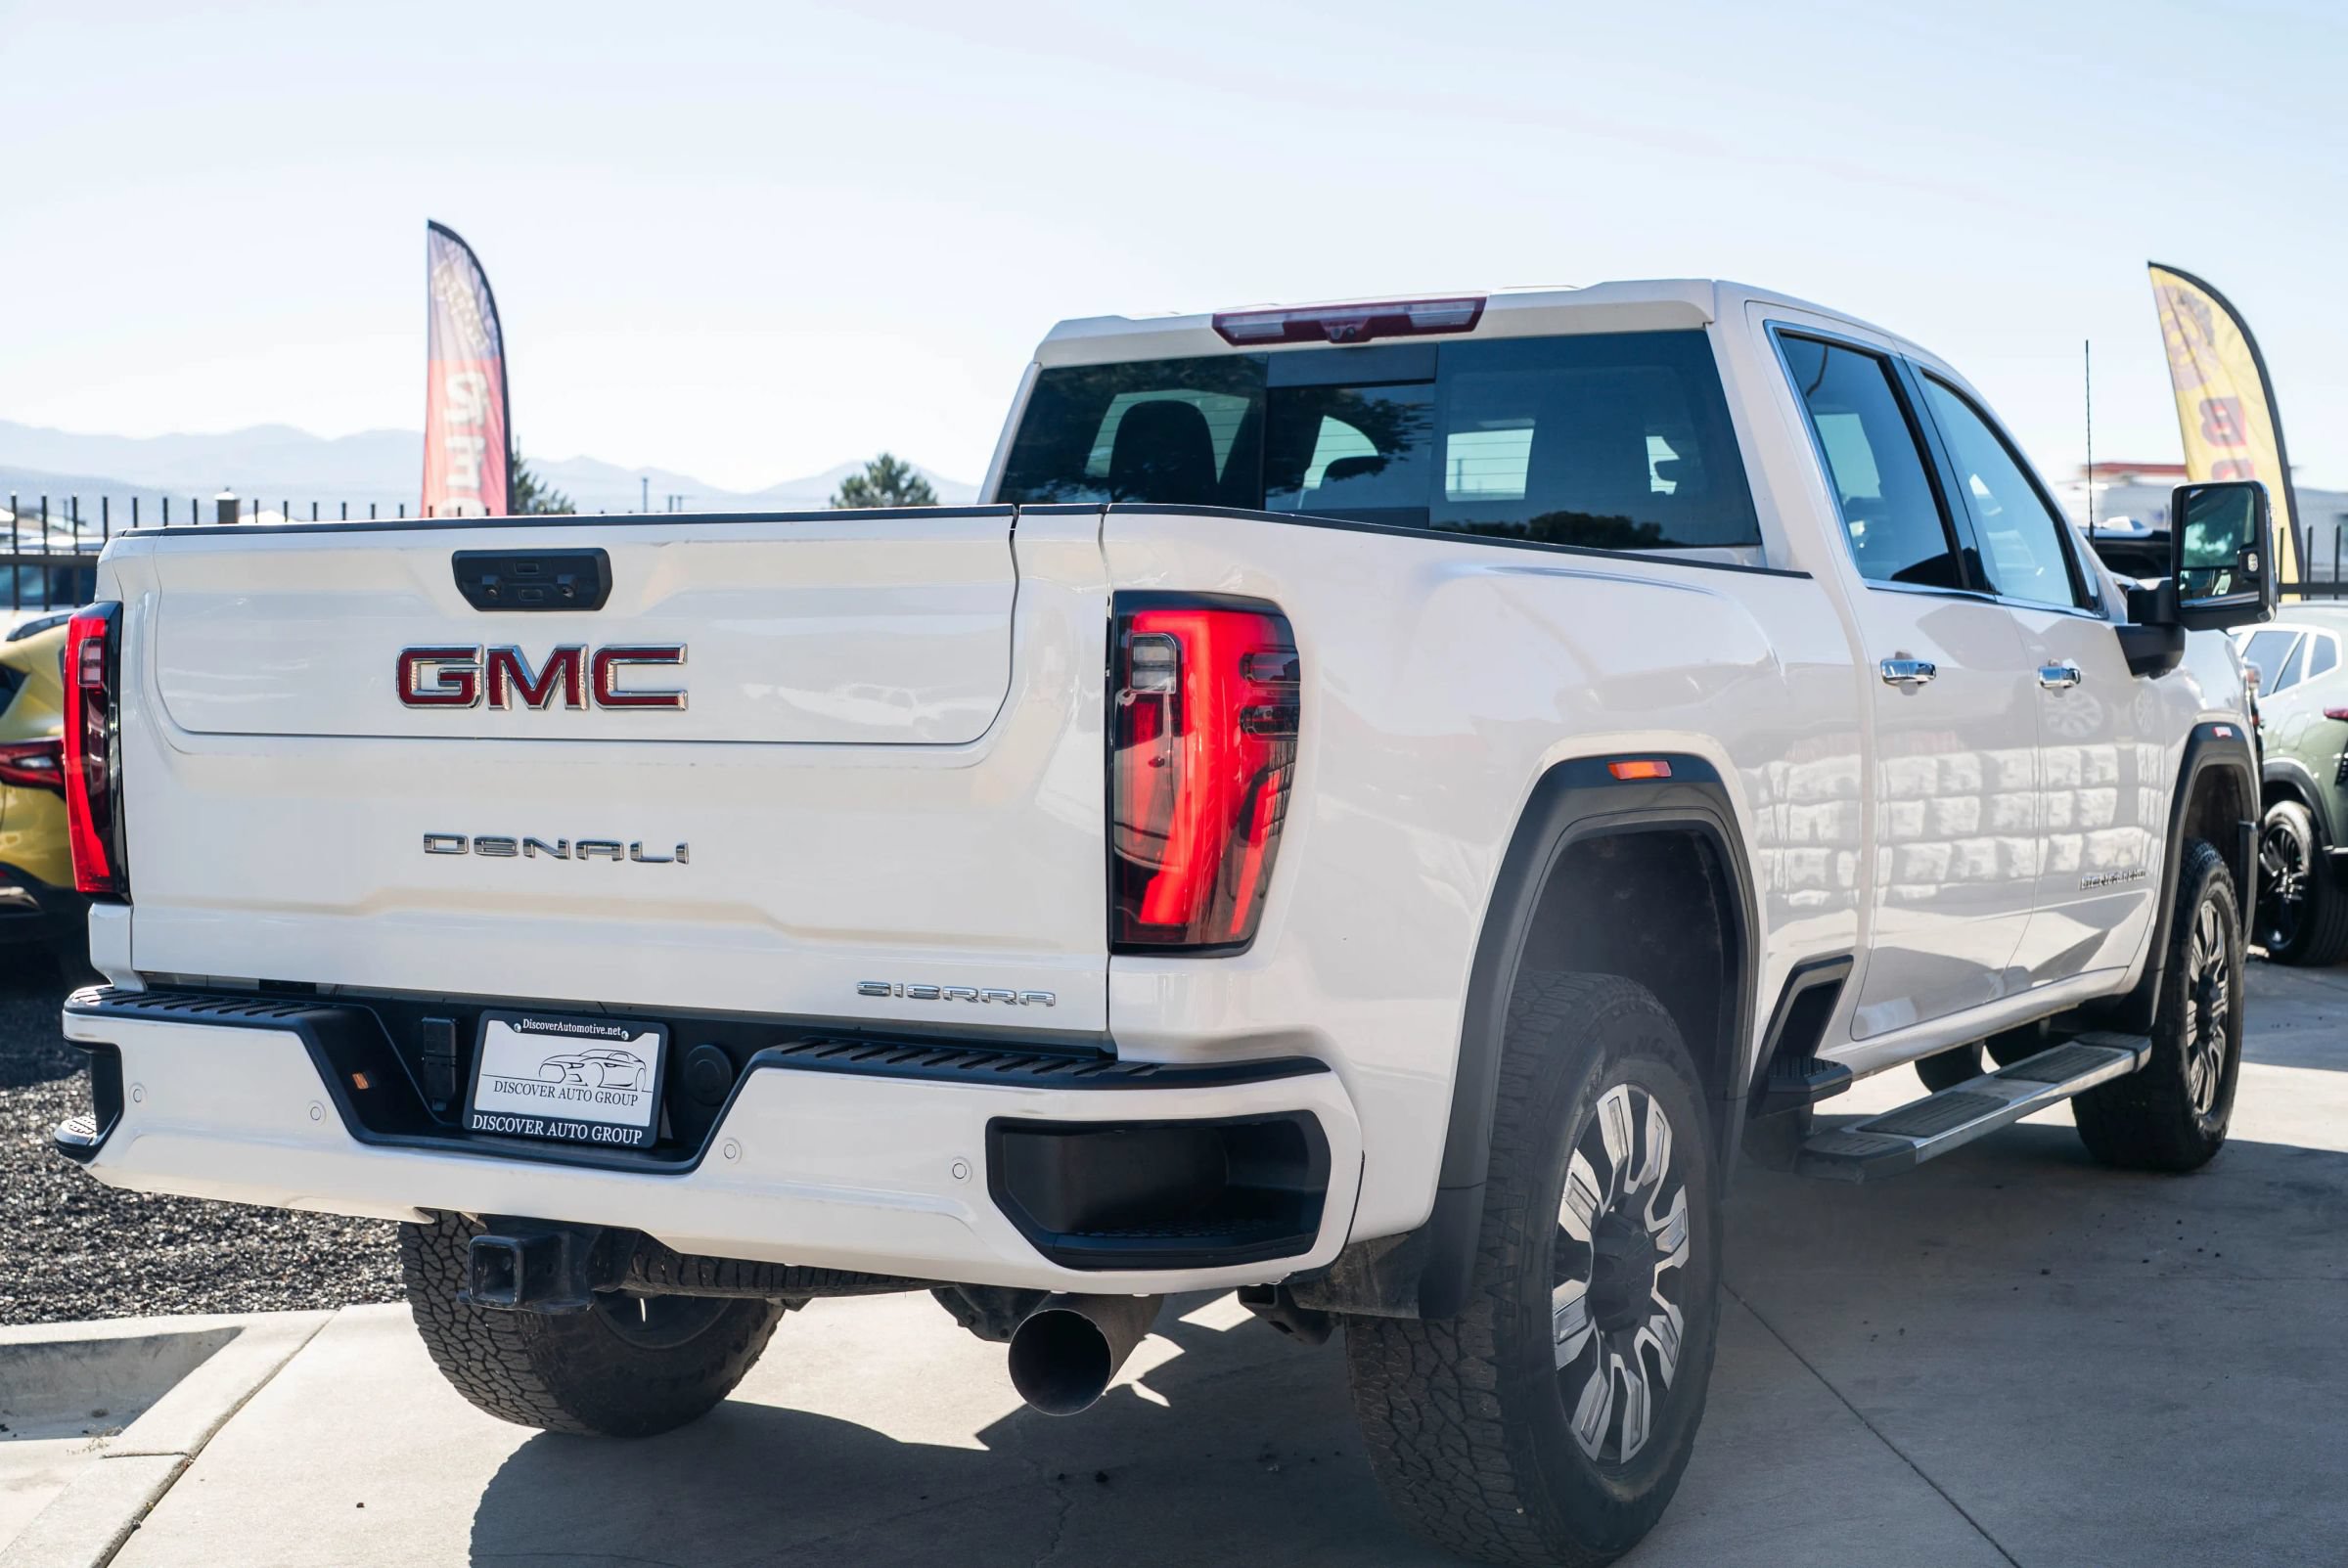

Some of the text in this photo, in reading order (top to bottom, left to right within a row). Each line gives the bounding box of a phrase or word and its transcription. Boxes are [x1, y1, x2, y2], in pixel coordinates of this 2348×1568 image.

[395, 643, 688, 712] GMC
[423, 831, 690, 866] DENALI
[856, 980, 1057, 1008] SIERRA
[522, 1018, 621, 1036] DiscoverAutomotive.net
[494, 1080, 639, 1107] DISCOVER AUTO GROUP
[472, 1114, 643, 1144] DISCOVER AUTO GROUP
